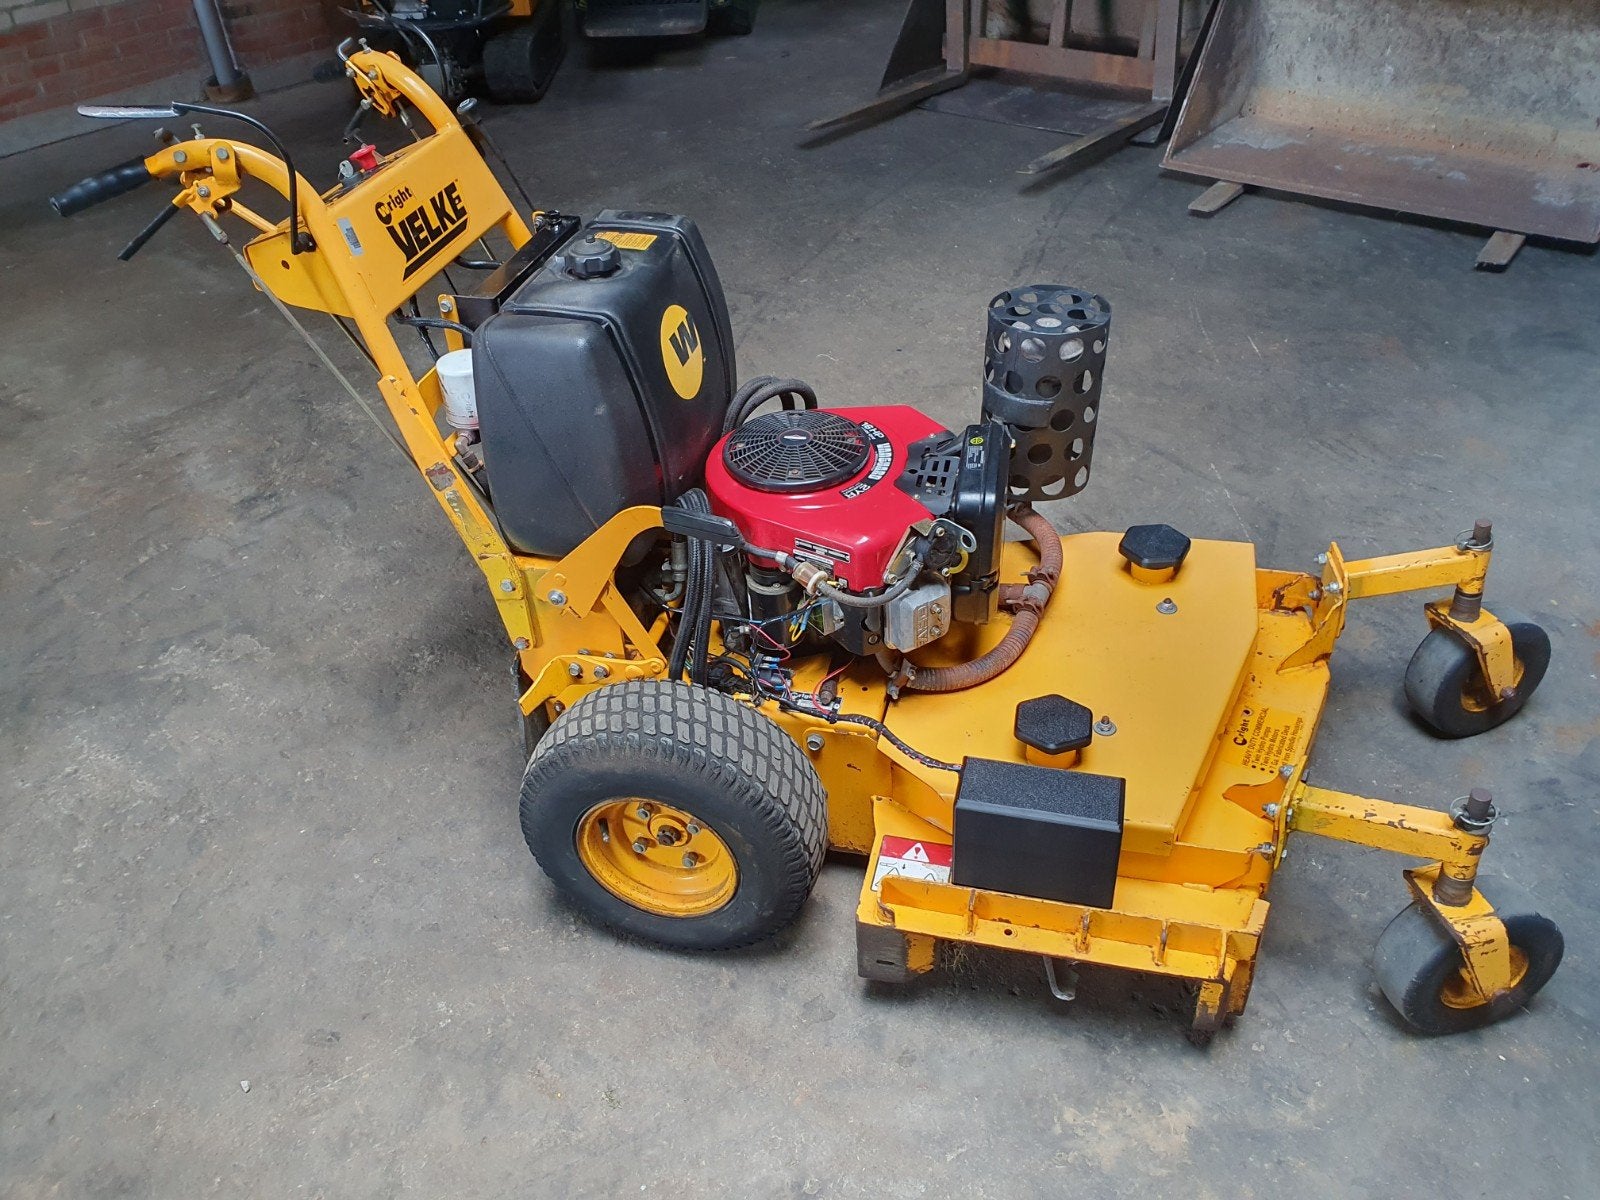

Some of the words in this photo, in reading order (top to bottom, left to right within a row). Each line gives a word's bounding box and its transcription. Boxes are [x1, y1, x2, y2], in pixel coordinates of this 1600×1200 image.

[386, 181, 468, 263] VELKE
[1249, 737, 1257, 750] DUTY
[1253, 707, 1269, 737] COMMERCIAL
